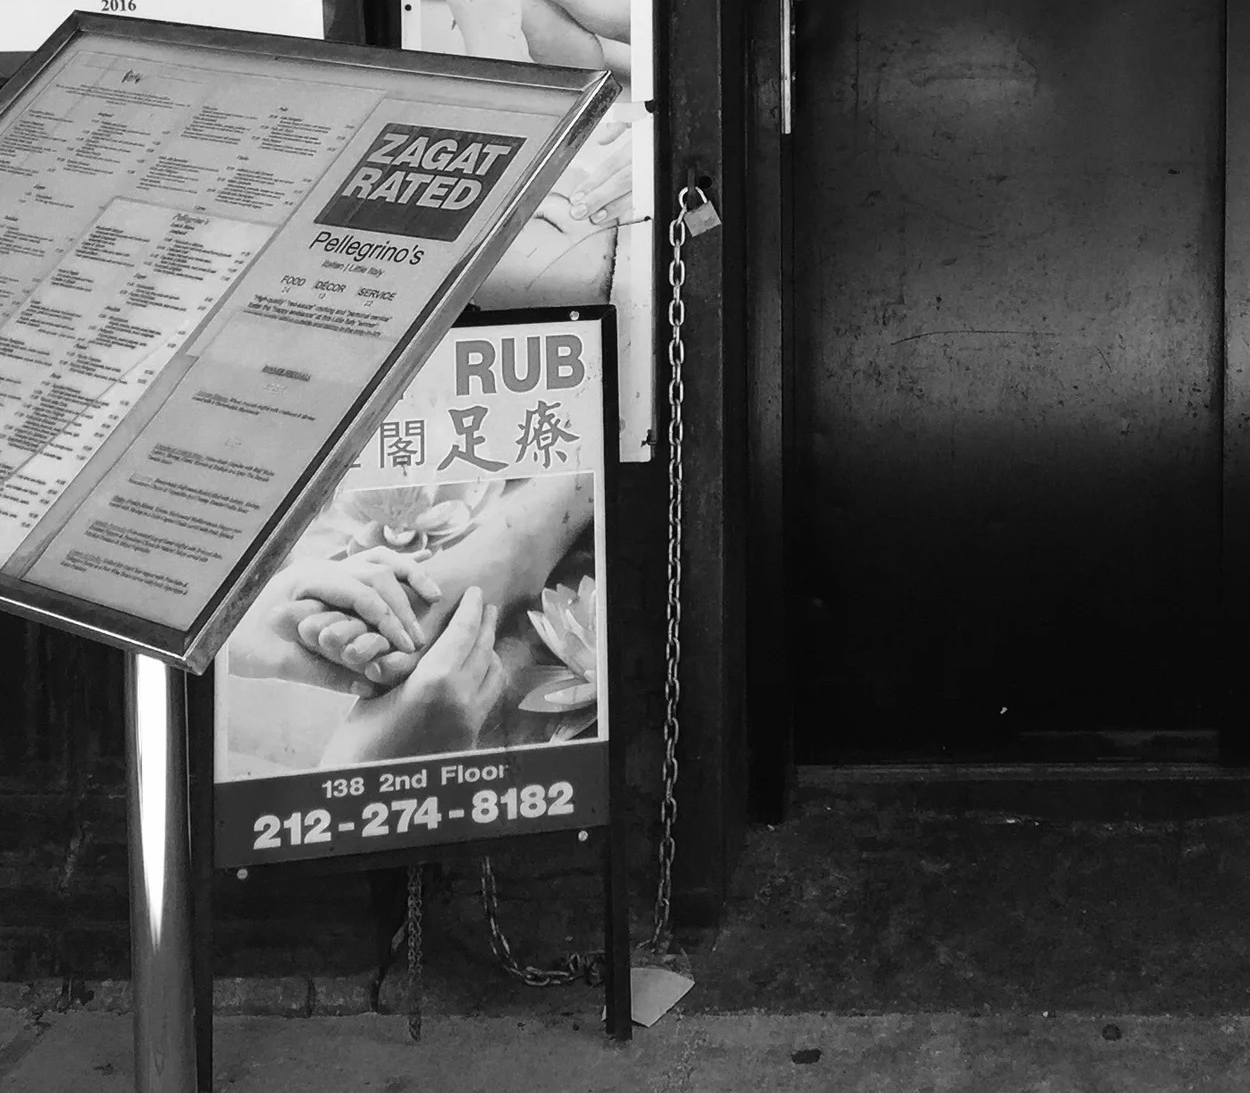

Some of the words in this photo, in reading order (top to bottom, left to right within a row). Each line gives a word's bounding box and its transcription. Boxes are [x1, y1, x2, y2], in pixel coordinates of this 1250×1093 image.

[366, 133, 512, 176] ZAGAT
[341, 166, 482, 211] RATED
[309, 231, 425, 265] Pellegrino's
[281, 275, 307, 287] FOOD
[357, 287, 397, 302] SERVICE
[455, 334, 585, 396] RUB
[350, 400, 580, 472] 閣足療
[321, 777, 365, 798] 138
[379, 769, 428, 793] 2nd
[441, 764, 508, 786] Floor
[253, 781, 575, 850] 212-274-8182
